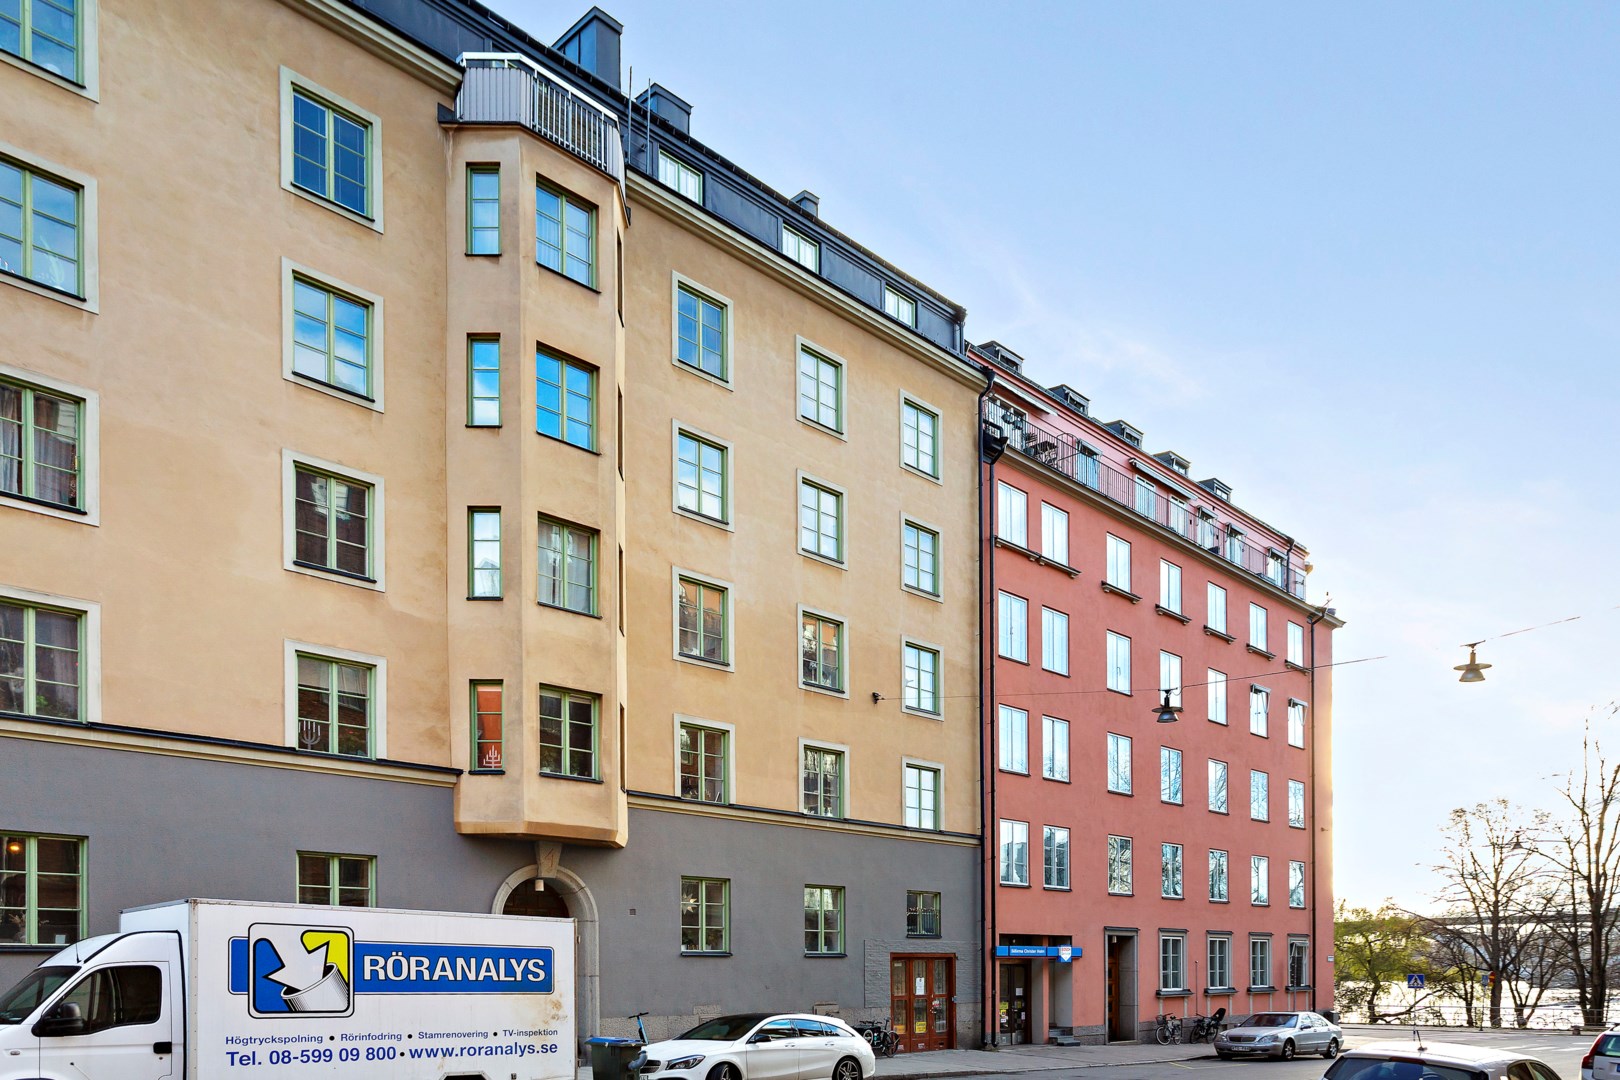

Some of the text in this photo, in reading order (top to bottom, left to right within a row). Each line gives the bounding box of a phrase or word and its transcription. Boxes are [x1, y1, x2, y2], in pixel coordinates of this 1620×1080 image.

[363, 951, 546, 982] RÖRANALYS
[225, 1028, 558, 1046] Högtryckspolning Rörinfodring Stamrenovering TV-inspektion
[225, 1042, 558, 1066] Tel. 08-599 09 800 www.roranalys.se
